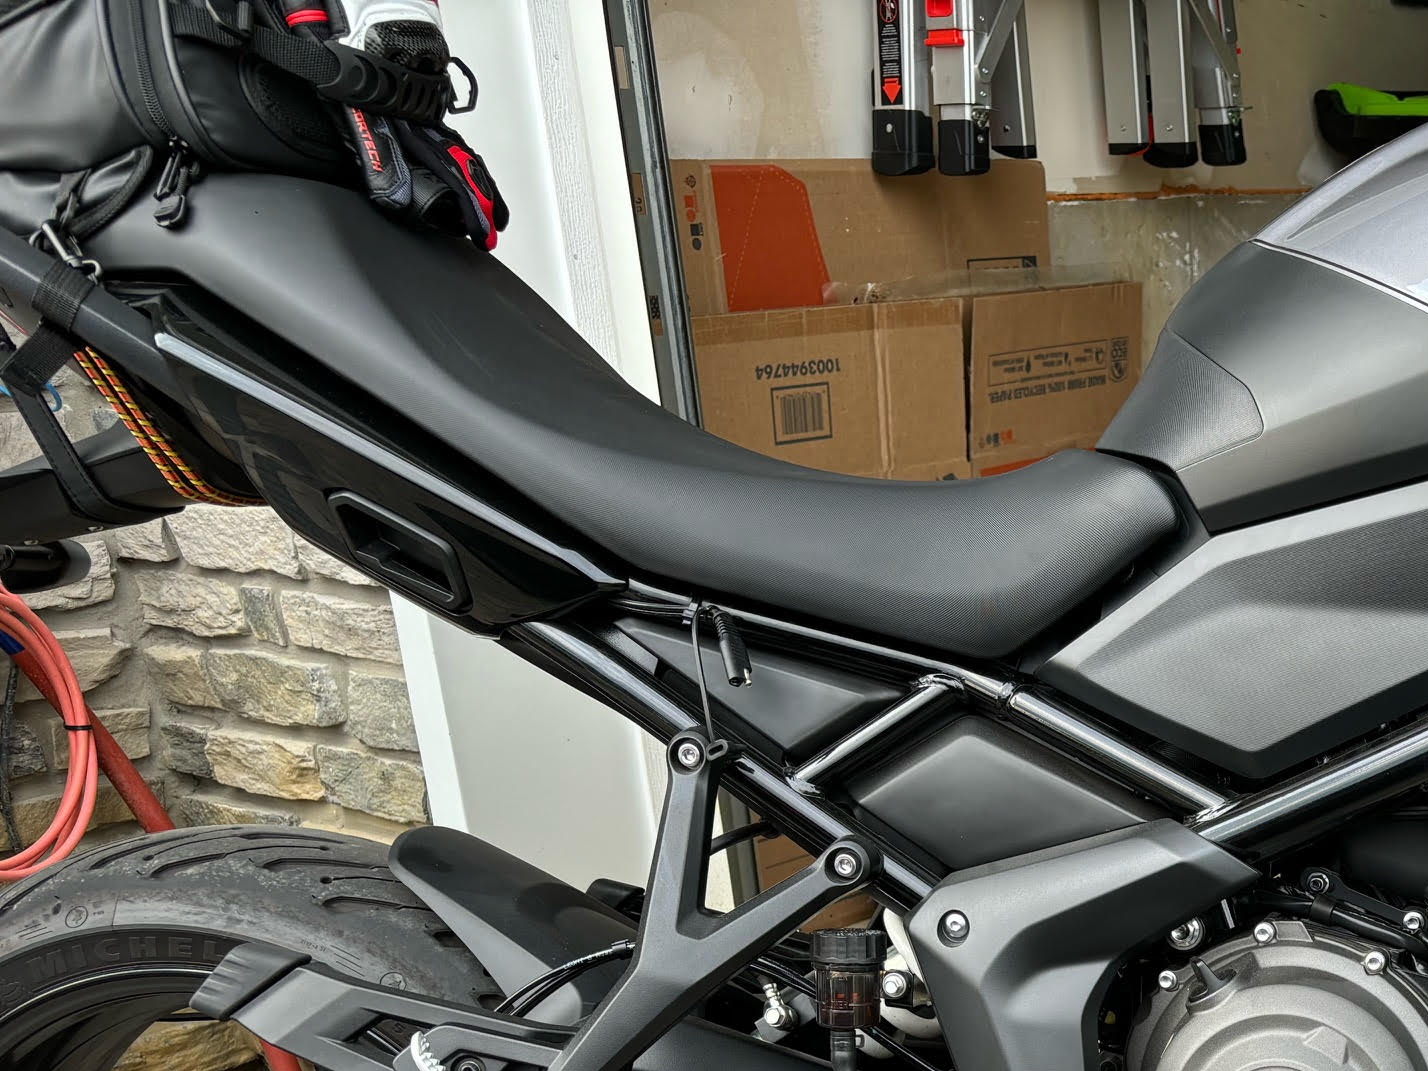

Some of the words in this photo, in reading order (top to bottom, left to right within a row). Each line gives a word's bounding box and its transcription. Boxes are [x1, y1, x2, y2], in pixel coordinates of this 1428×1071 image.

[352, 107, 384, 173] ORTECH
[755, 358, 841, 380] 1003944764
[26, 936, 225, 980] MICHEL
